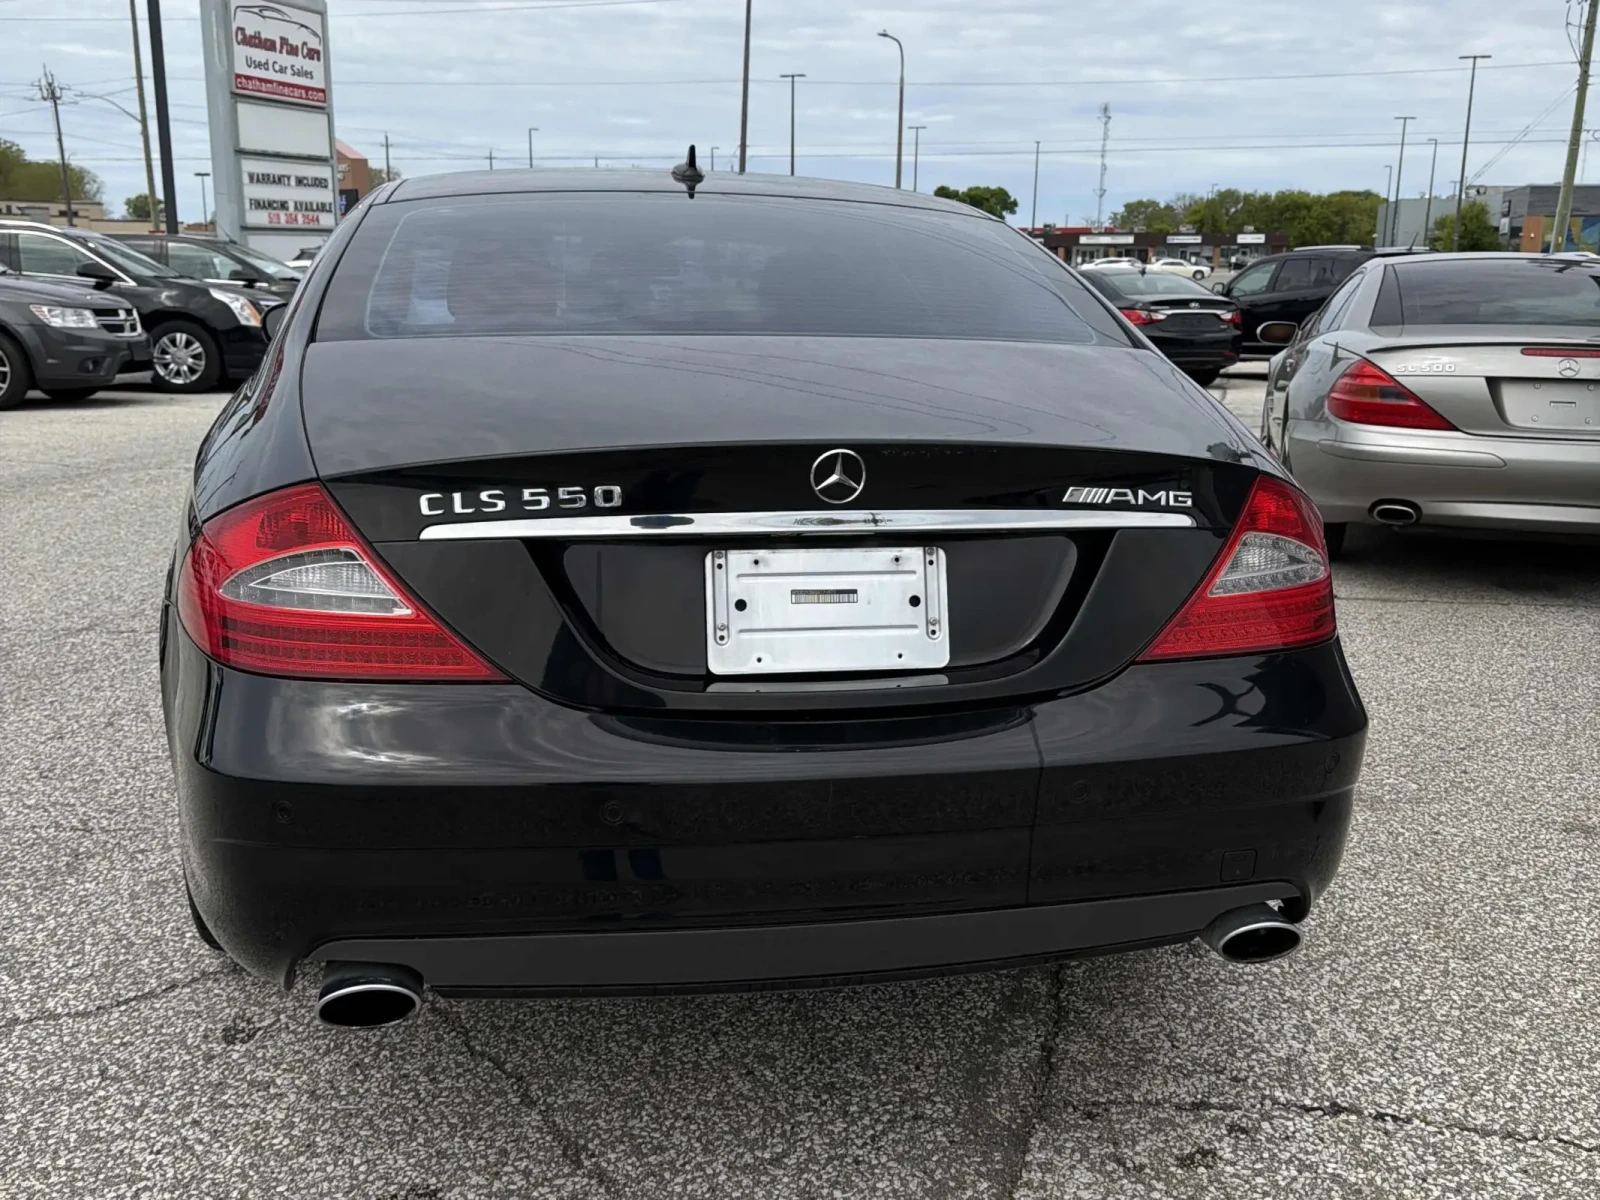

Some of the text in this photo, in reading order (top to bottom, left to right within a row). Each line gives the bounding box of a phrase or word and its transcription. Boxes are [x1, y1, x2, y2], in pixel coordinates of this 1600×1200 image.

[235, 26, 321, 62] Chatham Fine Cars
[245, 55, 314, 80] Used Car Sales
[247, 172, 291, 186] WARRANTY
[295, 176, 329, 189] INCLUDED
[249, 198, 289, 212] FINANCING
[294, 201, 333, 213] AVAILABLE
[1396, 364, 1456, 373] SL 500
[419, 485, 623, 515] CLS 550
[1104, 488, 1193, 507] AMG
